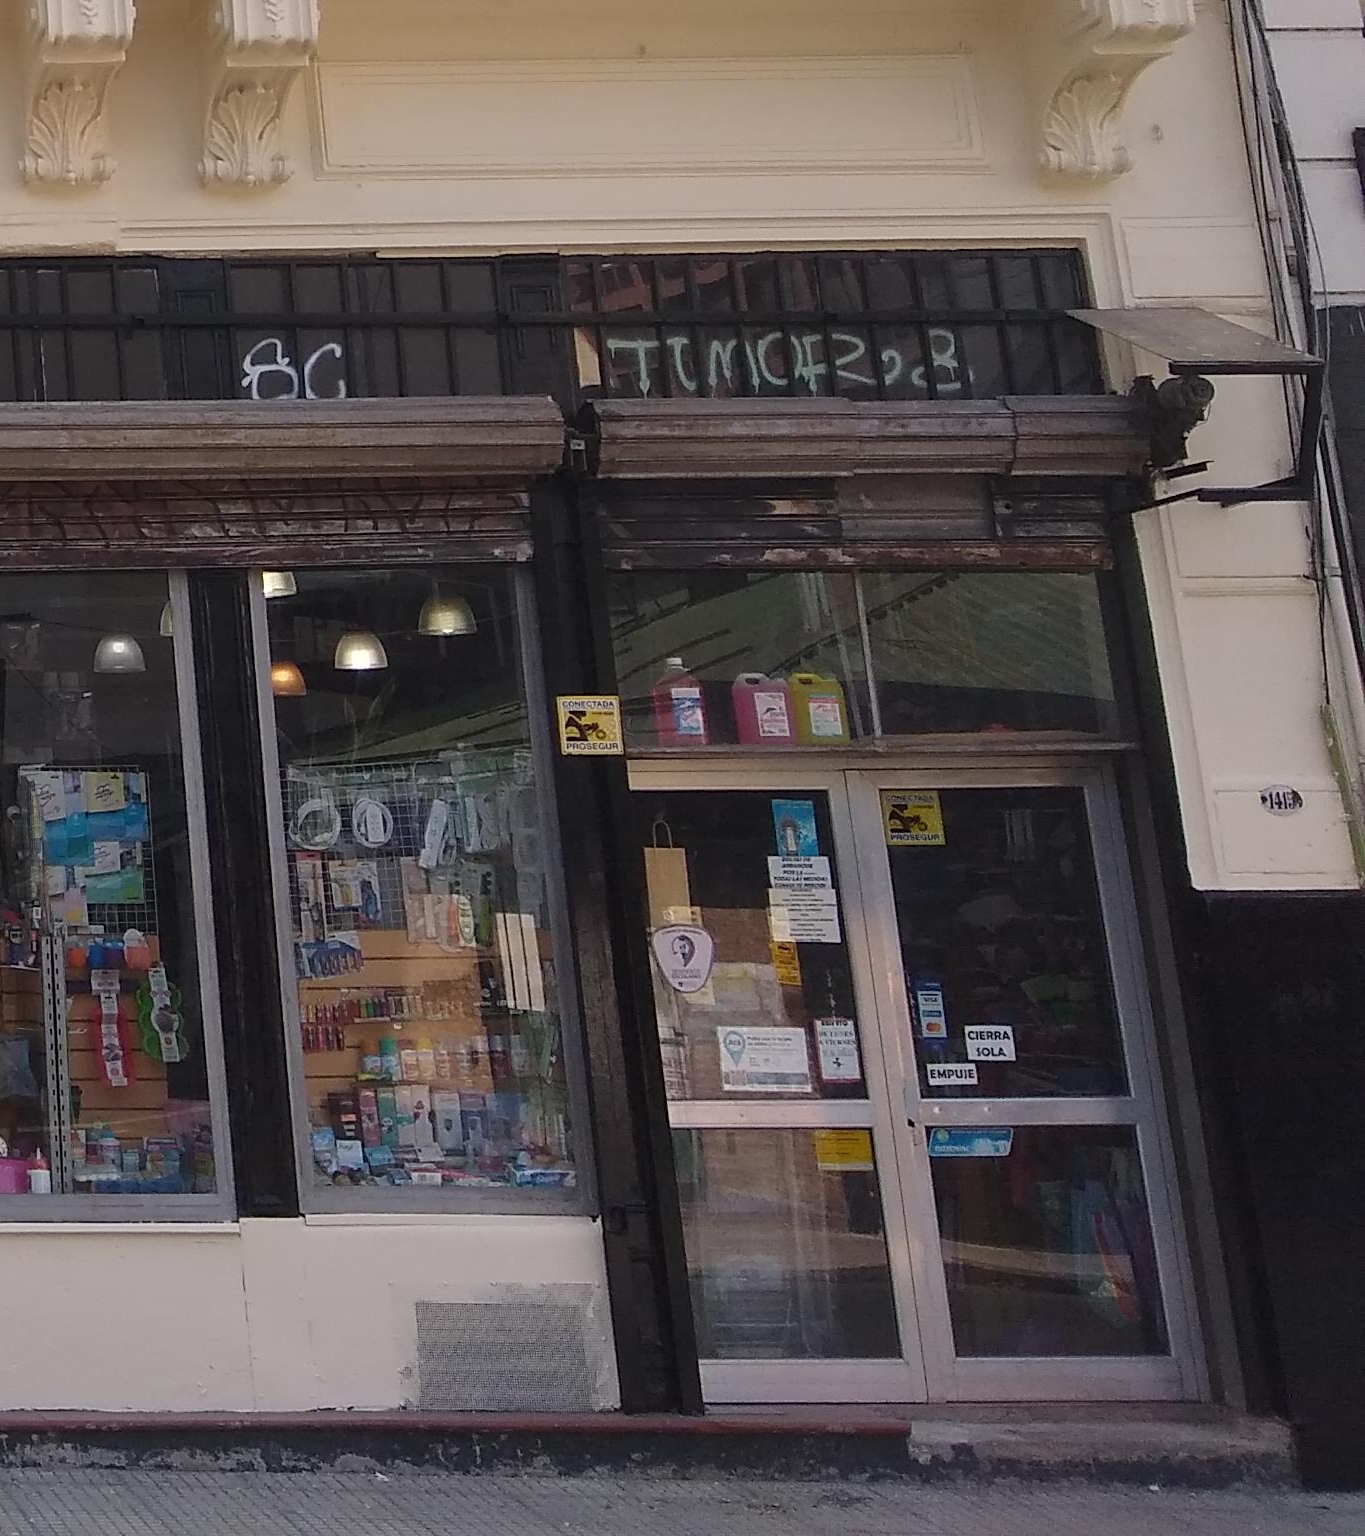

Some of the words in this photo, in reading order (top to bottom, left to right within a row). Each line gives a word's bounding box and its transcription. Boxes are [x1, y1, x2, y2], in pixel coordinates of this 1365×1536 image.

[562, 700, 615, 709] CONECTADA
[566, 743, 619, 751] PROSEGUR
[890, 833, 940, 841] PROSEGUR
[968, 1031, 1011, 1041] CIERRA
[976, 1047, 1007, 1057] SOLA
[930, 1068, 975, 1079] EMPUJE
